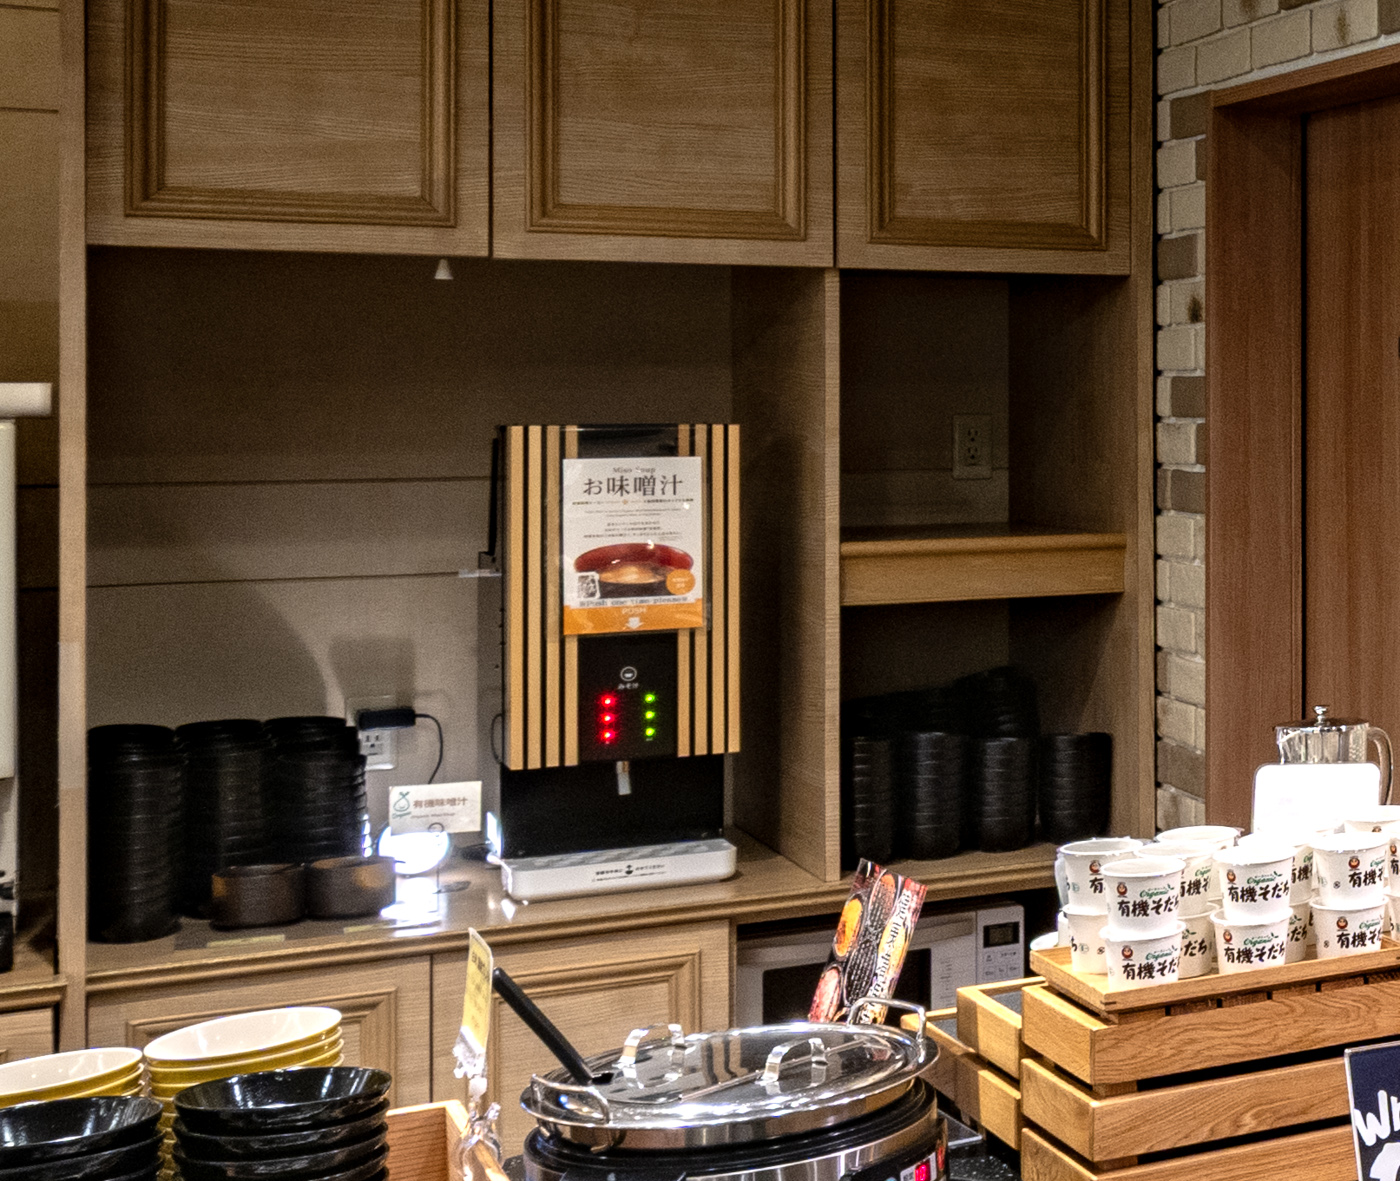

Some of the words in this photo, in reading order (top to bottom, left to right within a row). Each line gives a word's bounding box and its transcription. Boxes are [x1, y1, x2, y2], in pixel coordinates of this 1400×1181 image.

[583, 474, 683, 497] お味噌汁
[1228, 879, 1290, 903] 有機そだち
[1224, 940, 1286, 964] 有機そだち
